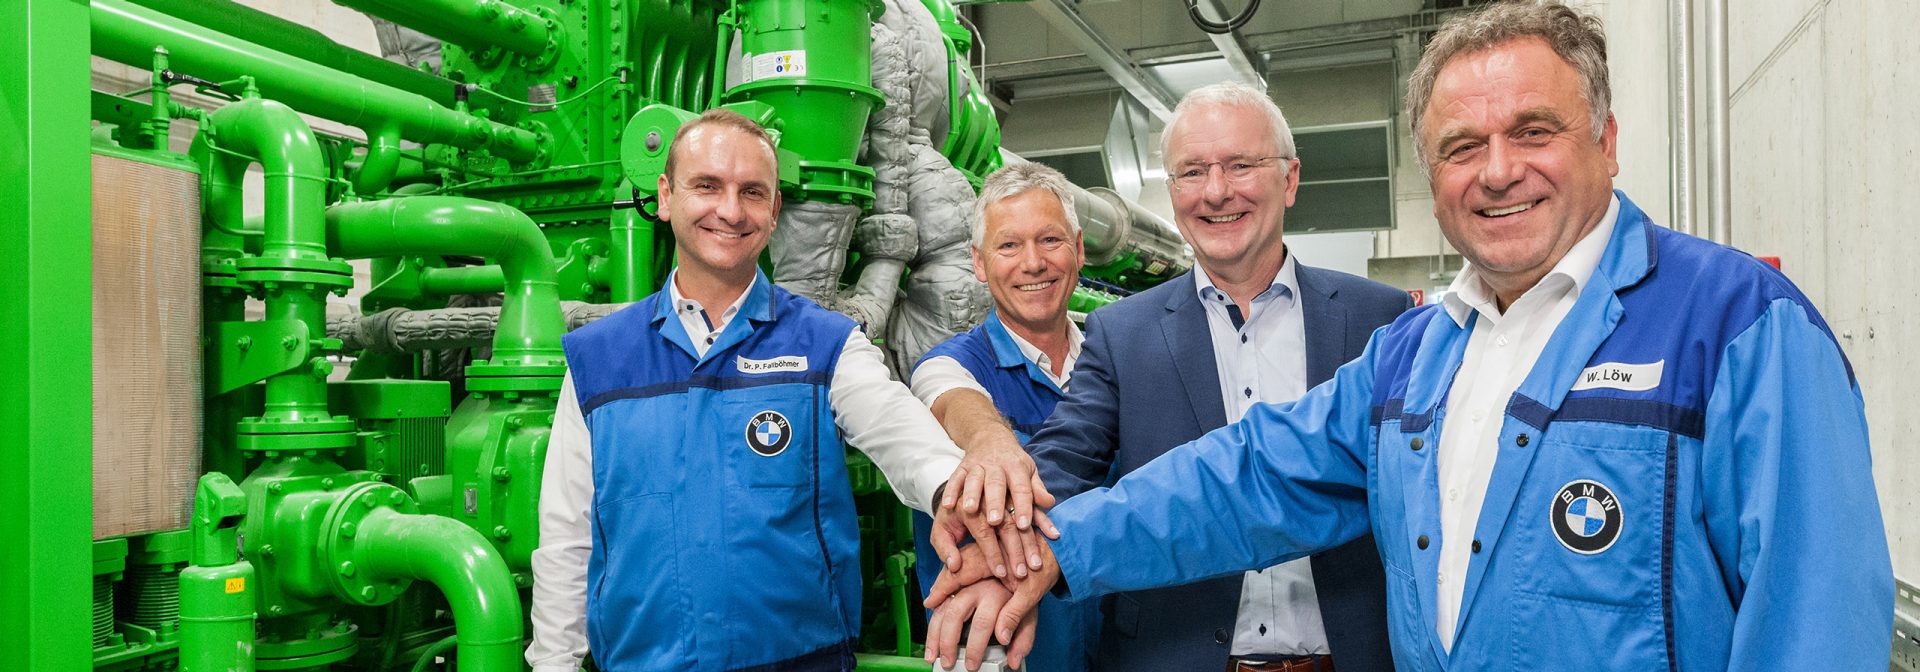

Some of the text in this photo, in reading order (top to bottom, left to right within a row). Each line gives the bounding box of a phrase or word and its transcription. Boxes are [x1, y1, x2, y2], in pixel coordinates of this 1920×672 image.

[744, 362, 754, 370] Dr.
[1587, 369, 1632, 382] W. Löw
[752, 413, 787, 429] BMW
[1561, 484, 1616, 511] BMW
